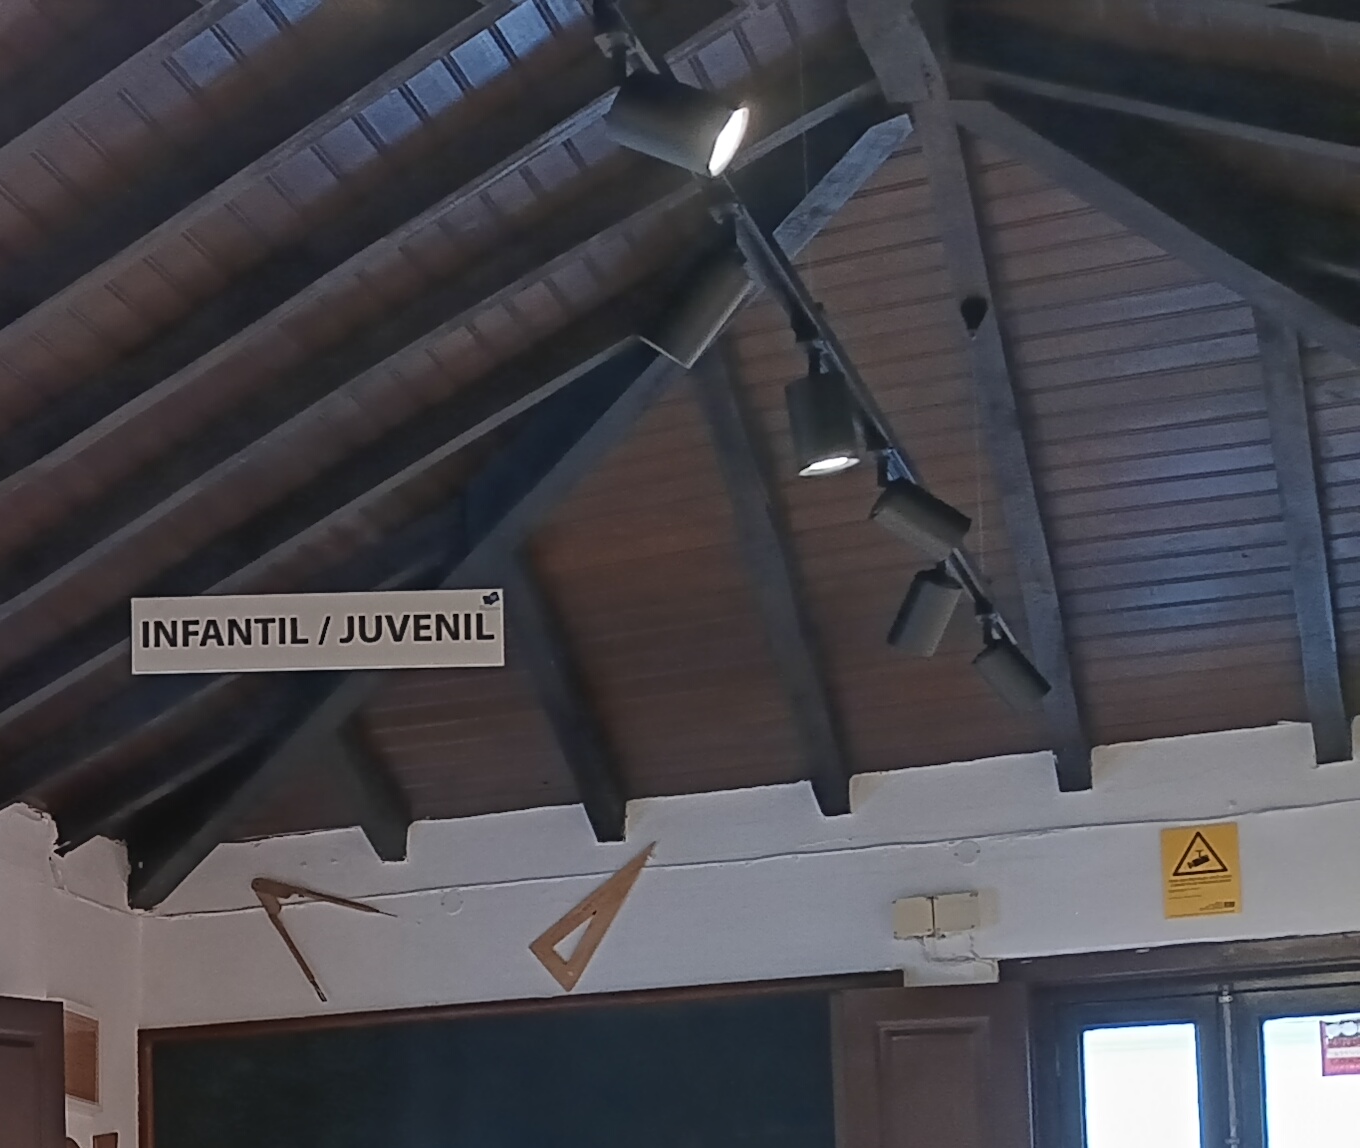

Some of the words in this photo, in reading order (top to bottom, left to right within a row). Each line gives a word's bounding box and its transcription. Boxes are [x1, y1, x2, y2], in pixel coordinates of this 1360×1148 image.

[142, 616, 309, 648] INFANTIL
[318, 616, 330, 646] /
[339, 612, 495, 645] JUVENIL
